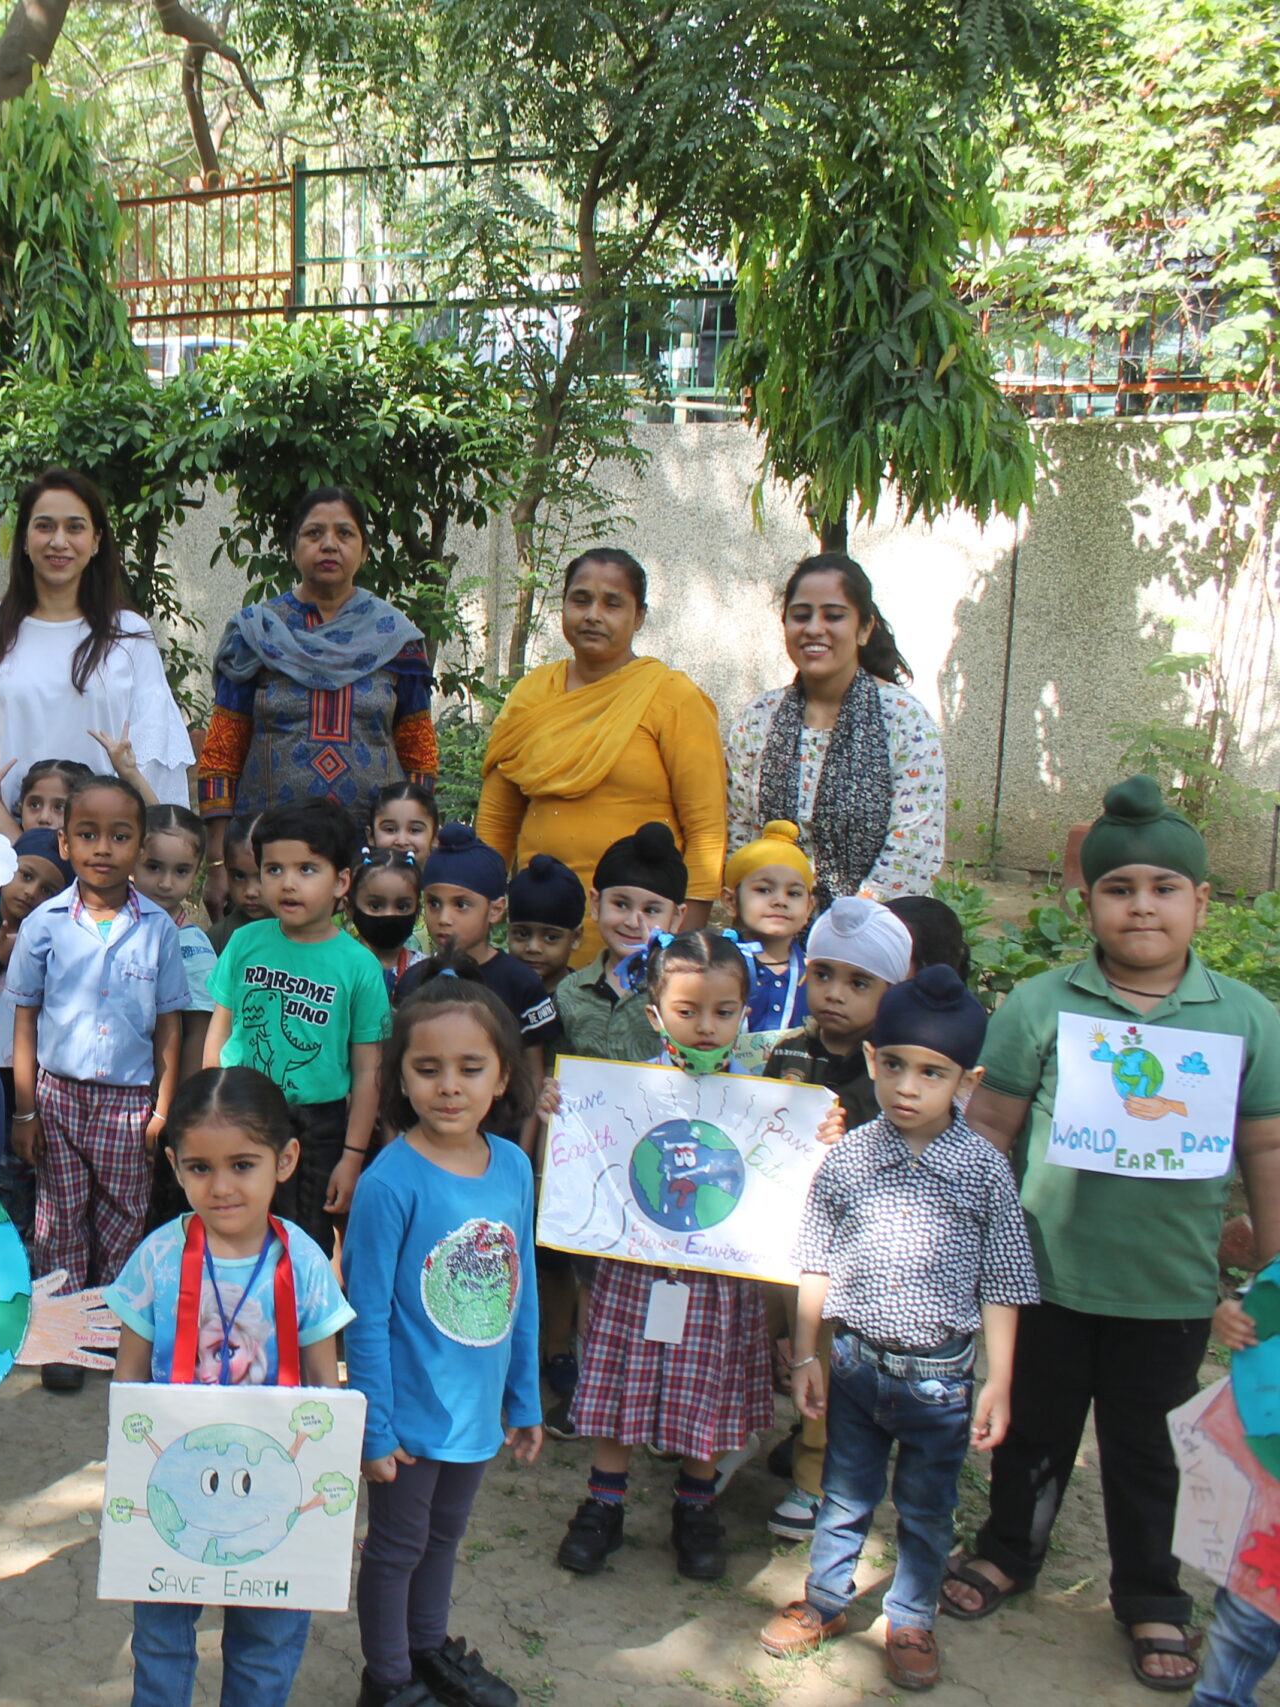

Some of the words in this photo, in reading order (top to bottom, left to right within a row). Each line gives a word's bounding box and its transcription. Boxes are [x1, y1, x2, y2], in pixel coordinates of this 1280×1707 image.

[284, 1002, 329, 1025] DINO
[1052, 1122, 1117, 1154] WORLD
[1181, 1131, 1231, 1153] DAY
[1114, 1149, 1184, 1171] EARTH
[148, 1566, 206, 1595] SAVE
[223, 1570, 289, 1598] EARTH
